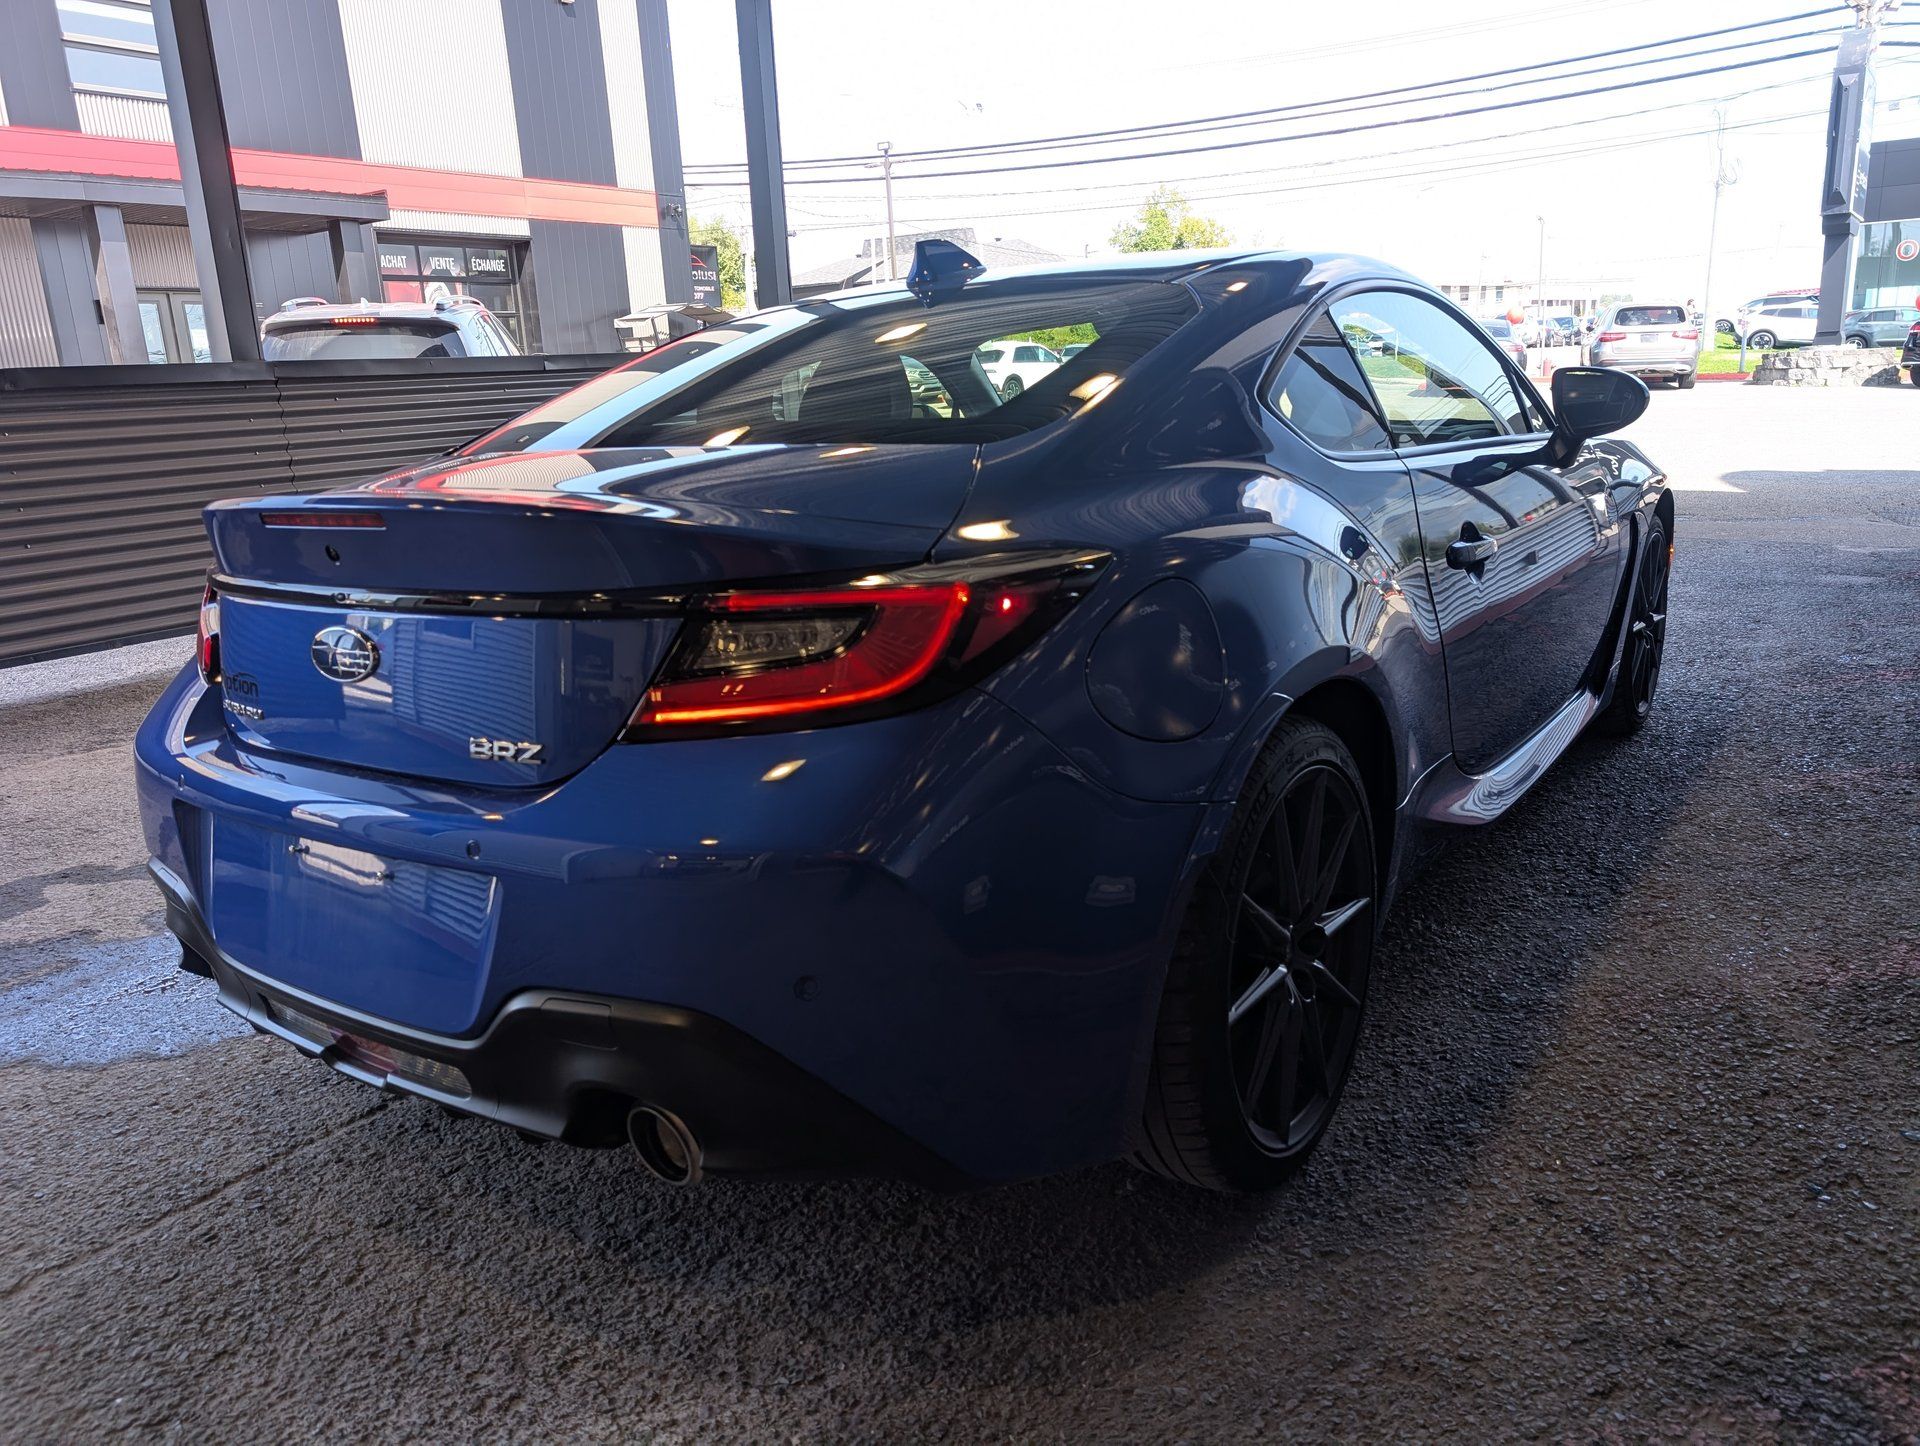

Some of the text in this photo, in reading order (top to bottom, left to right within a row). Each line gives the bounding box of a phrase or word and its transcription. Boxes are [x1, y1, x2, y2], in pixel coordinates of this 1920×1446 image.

[380, 254, 506, 272] ACHAT VENTE ÉCHANGE
[469, 736, 545, 764] BRZ
